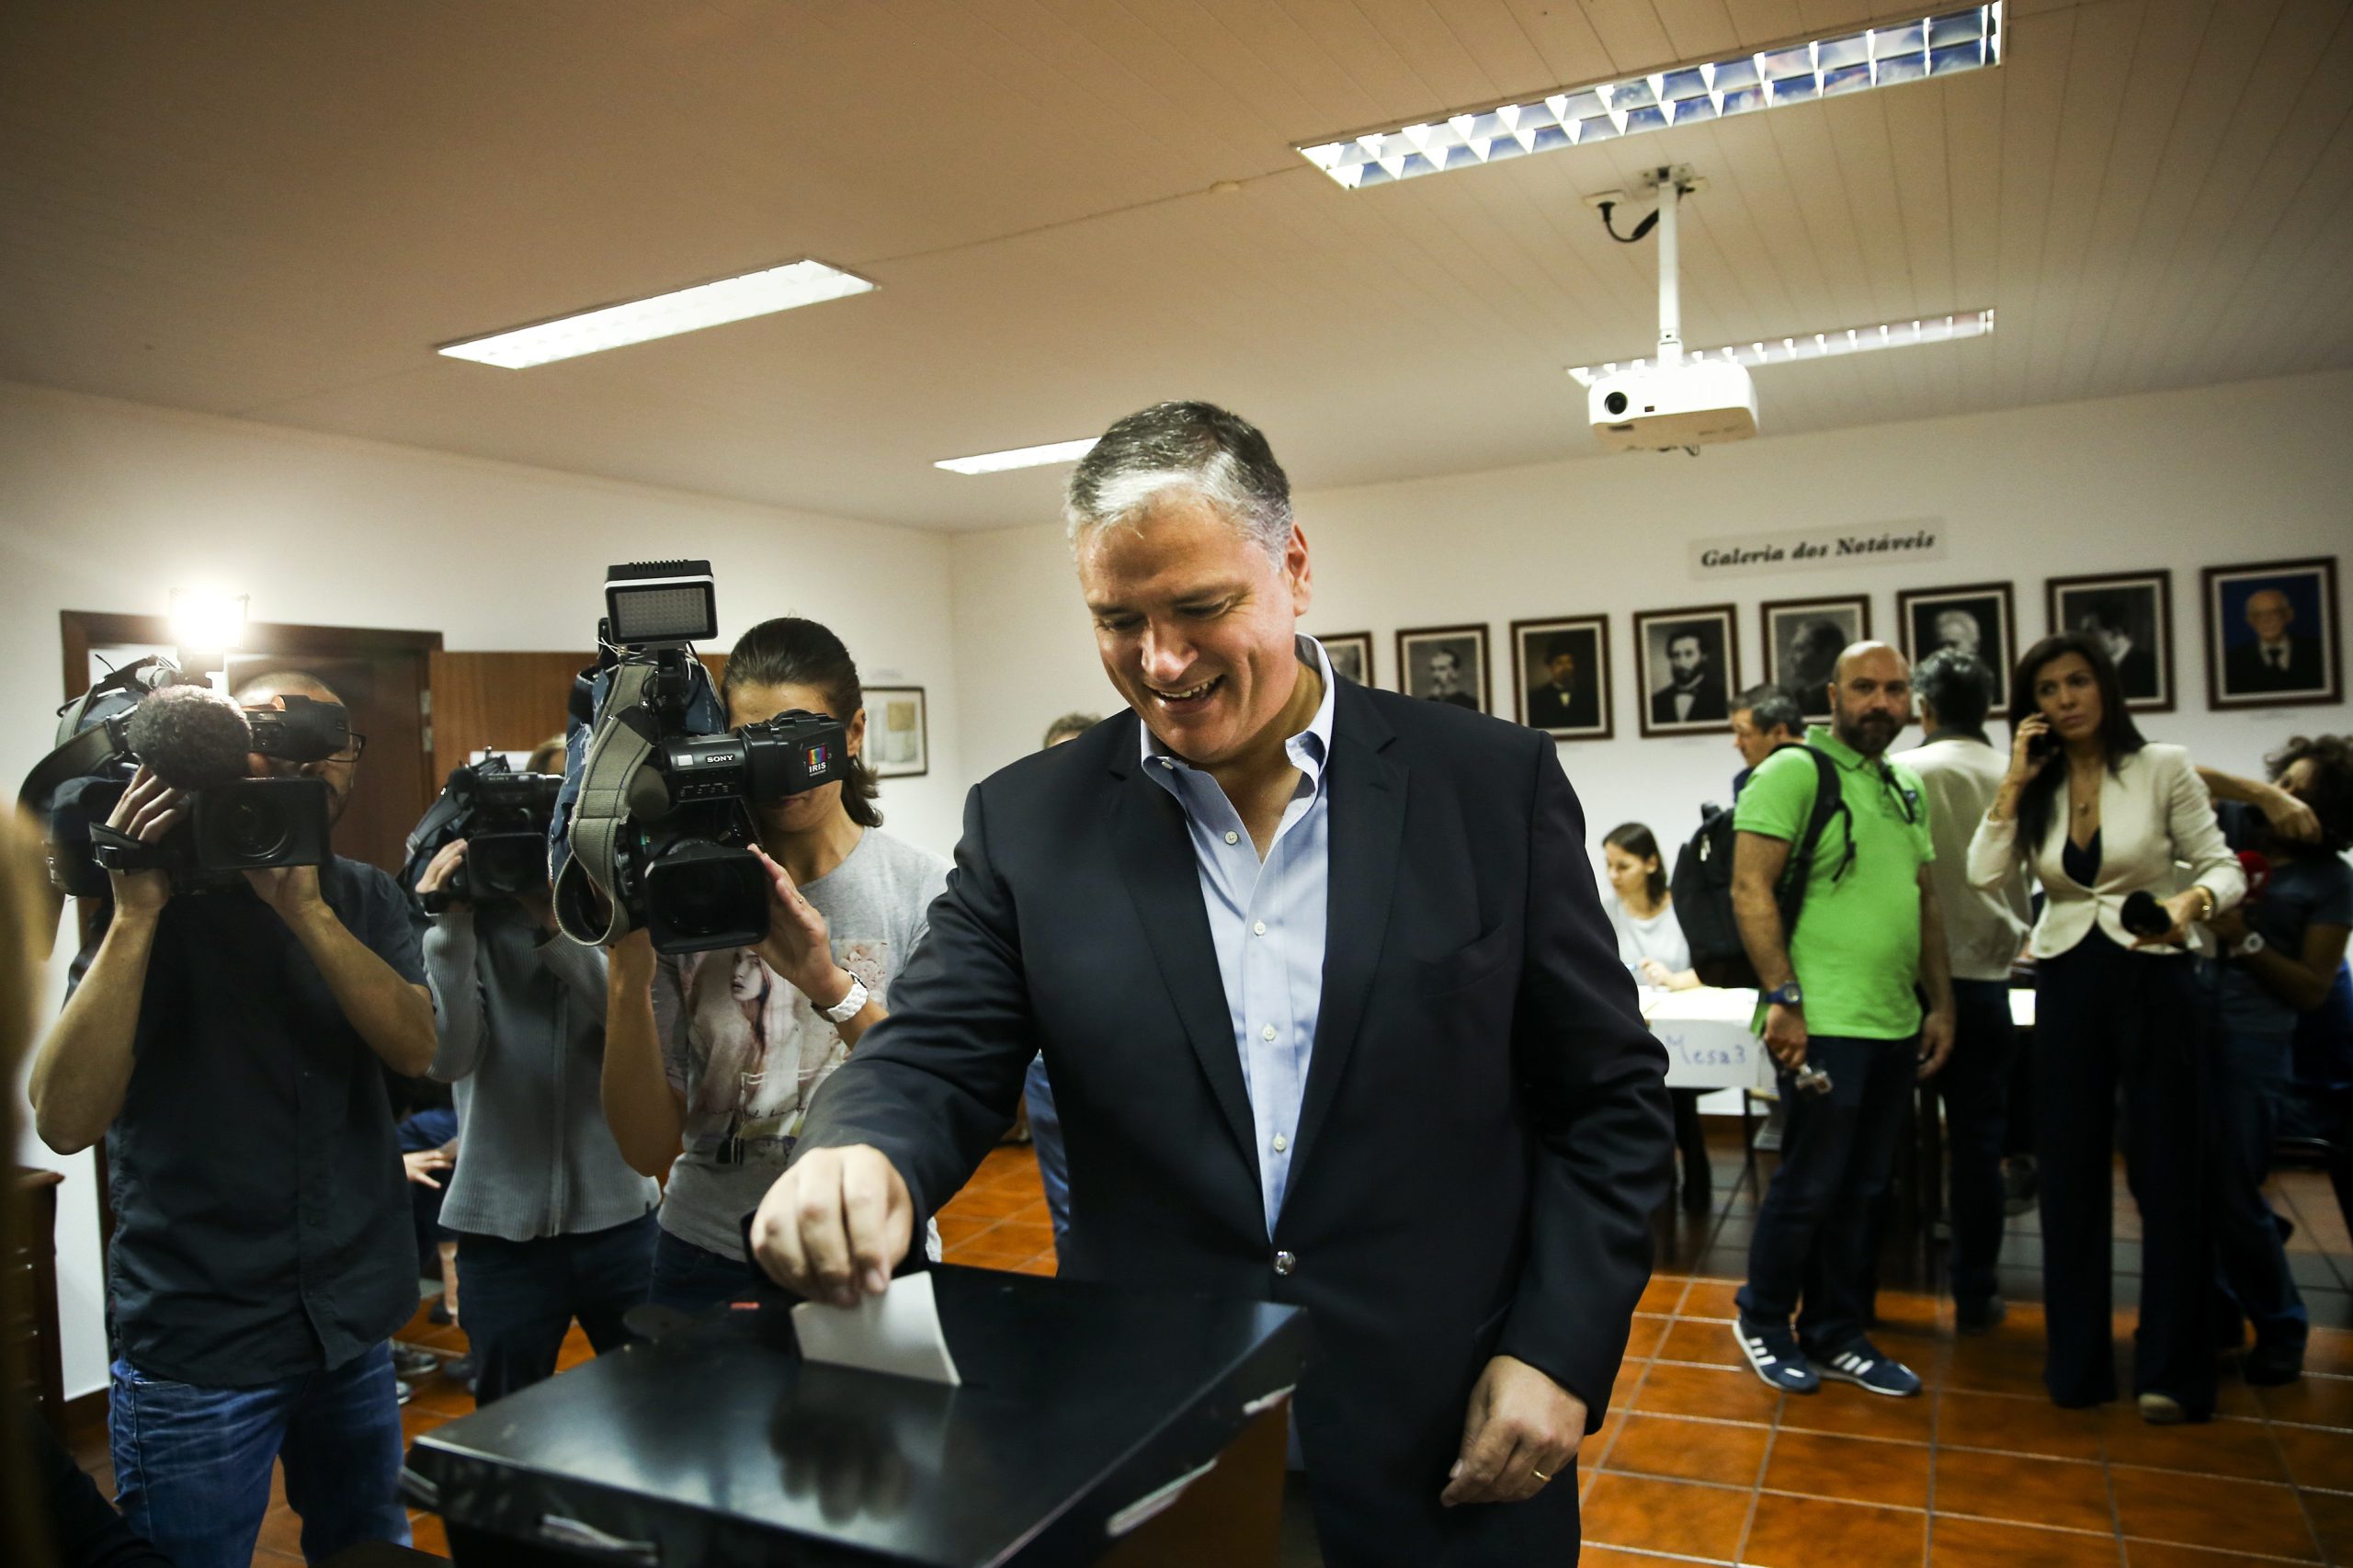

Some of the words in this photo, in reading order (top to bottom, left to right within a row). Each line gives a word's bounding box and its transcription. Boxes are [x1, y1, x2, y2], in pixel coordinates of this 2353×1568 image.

[1700, 543, 1784, 567] Galeria
[1791, 541, 1828, 561] dos
[1836, 529, 1935, 556] Notáveis
[706, 755, 733, 763] SONY
[809, 762, 826, 773] IRIS
